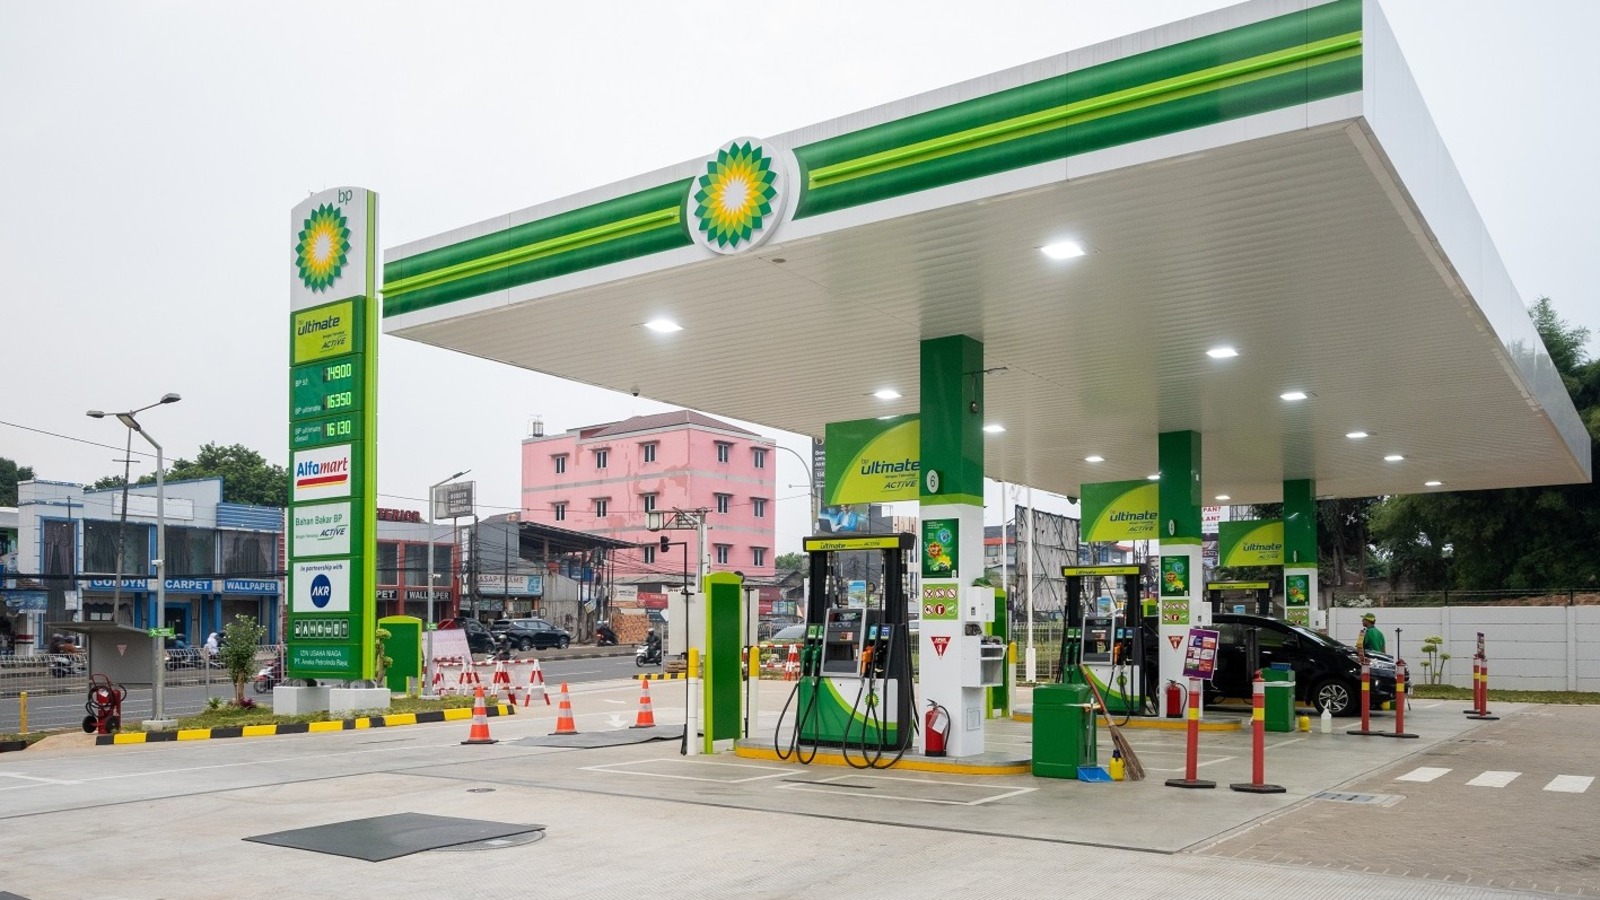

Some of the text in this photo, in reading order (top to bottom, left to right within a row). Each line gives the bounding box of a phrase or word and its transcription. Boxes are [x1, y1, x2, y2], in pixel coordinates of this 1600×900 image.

[338, 189, 352, 205] bp
[298, 315, 340, 336] ultimate
[322, 337, 346, 349] ACTIVE
[327, 363, 352, 381] 14900
[327, 392, 352, 408] 16350
[296, 456, 348, 477] Alfamart
[861, 458, 920, 475] ultimate
[884, 480, 917, 489] ACTIVE
[930, 475, 936, 488] 6
[296, 514, 342, 526] Bahan Bakar BP
[376, 508, 420, 523] TERIOR
[1110, 510, 1158, 521] ultimate
[320, 527, 346, 537] ACTIVE
[820, 540, 846, 550] ultimate
[1243, 544, 1282, 552] ultimate
[306, 564, 332, 572] partnership
[165, 580, 209, 590] CARPET
[226, 582, 275, 590] WALLPAPER
[312, 586, 330, 596] AKR
[410, 591, 449, 600] WALLAPER
